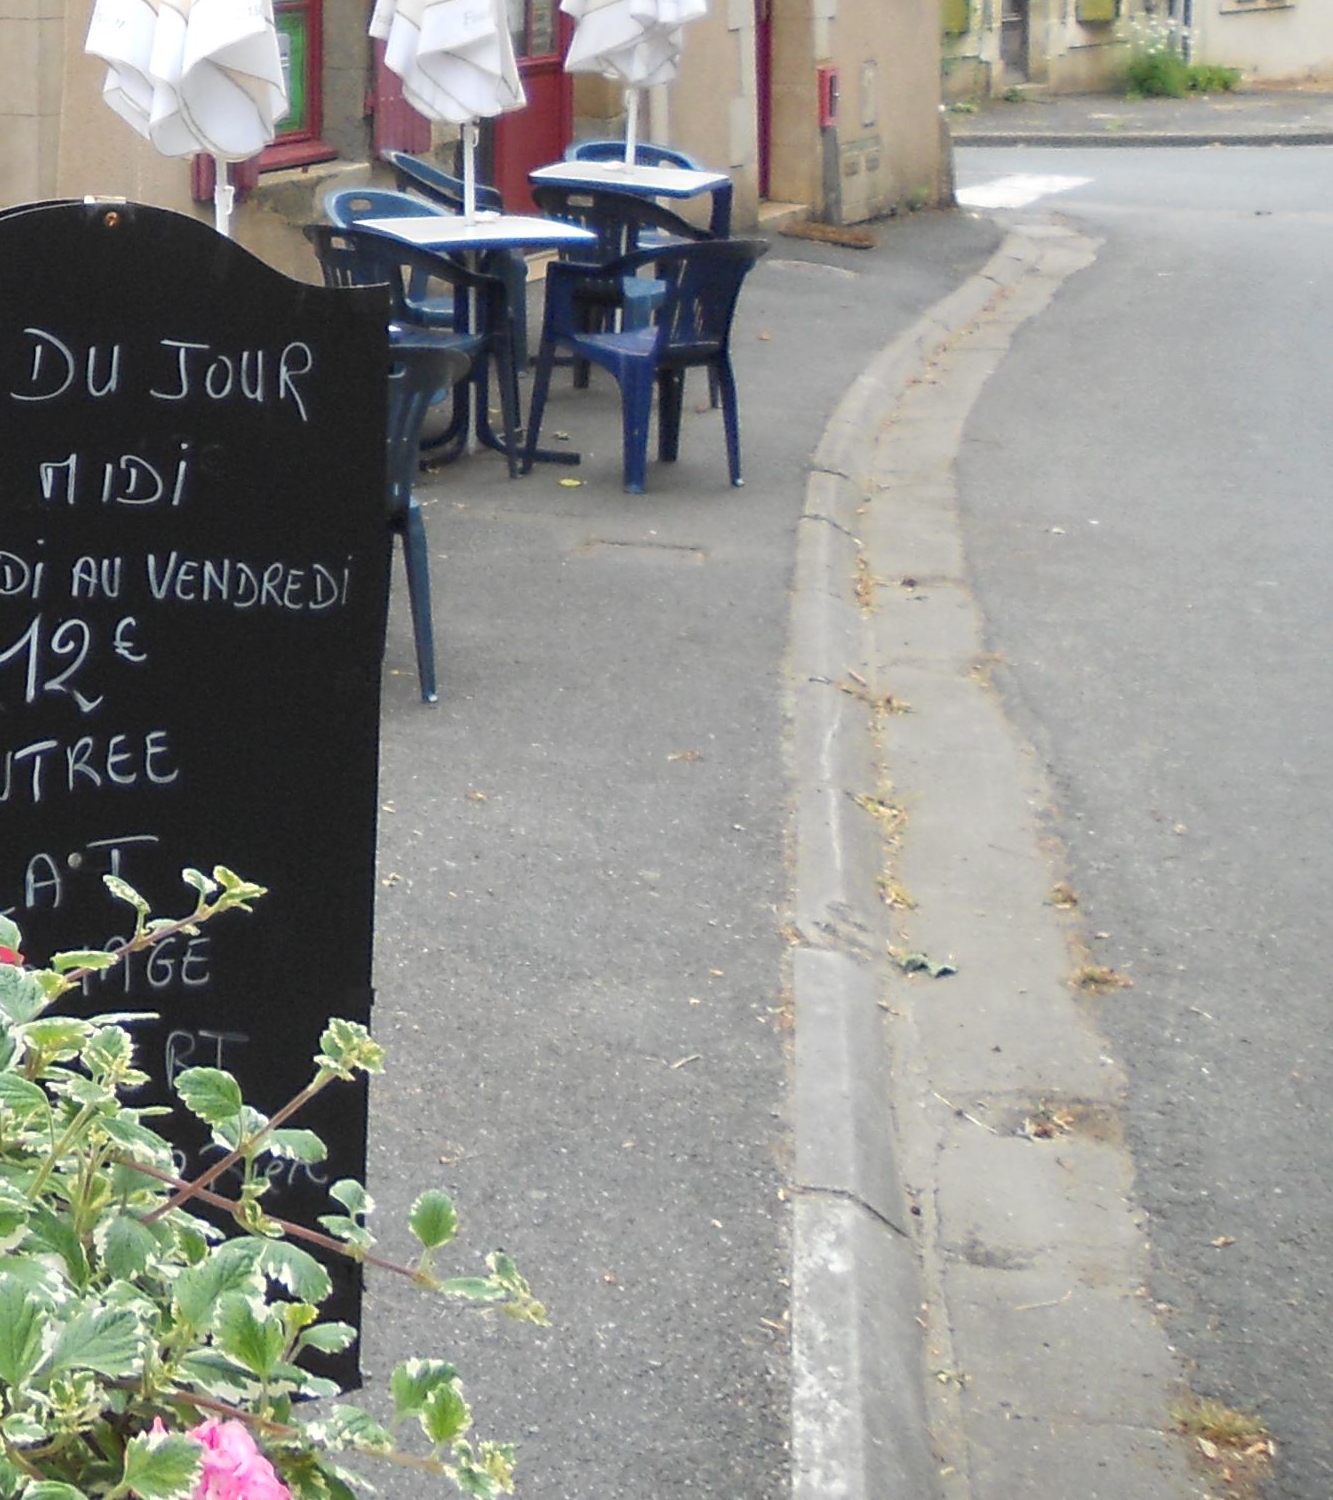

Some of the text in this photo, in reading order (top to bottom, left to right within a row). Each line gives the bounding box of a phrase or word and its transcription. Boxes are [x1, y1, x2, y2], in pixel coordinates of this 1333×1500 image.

[10, 327, 121, 402] DU
[149, 339, 314, 421] JOUR
[71, 555, 122, 599] AU
